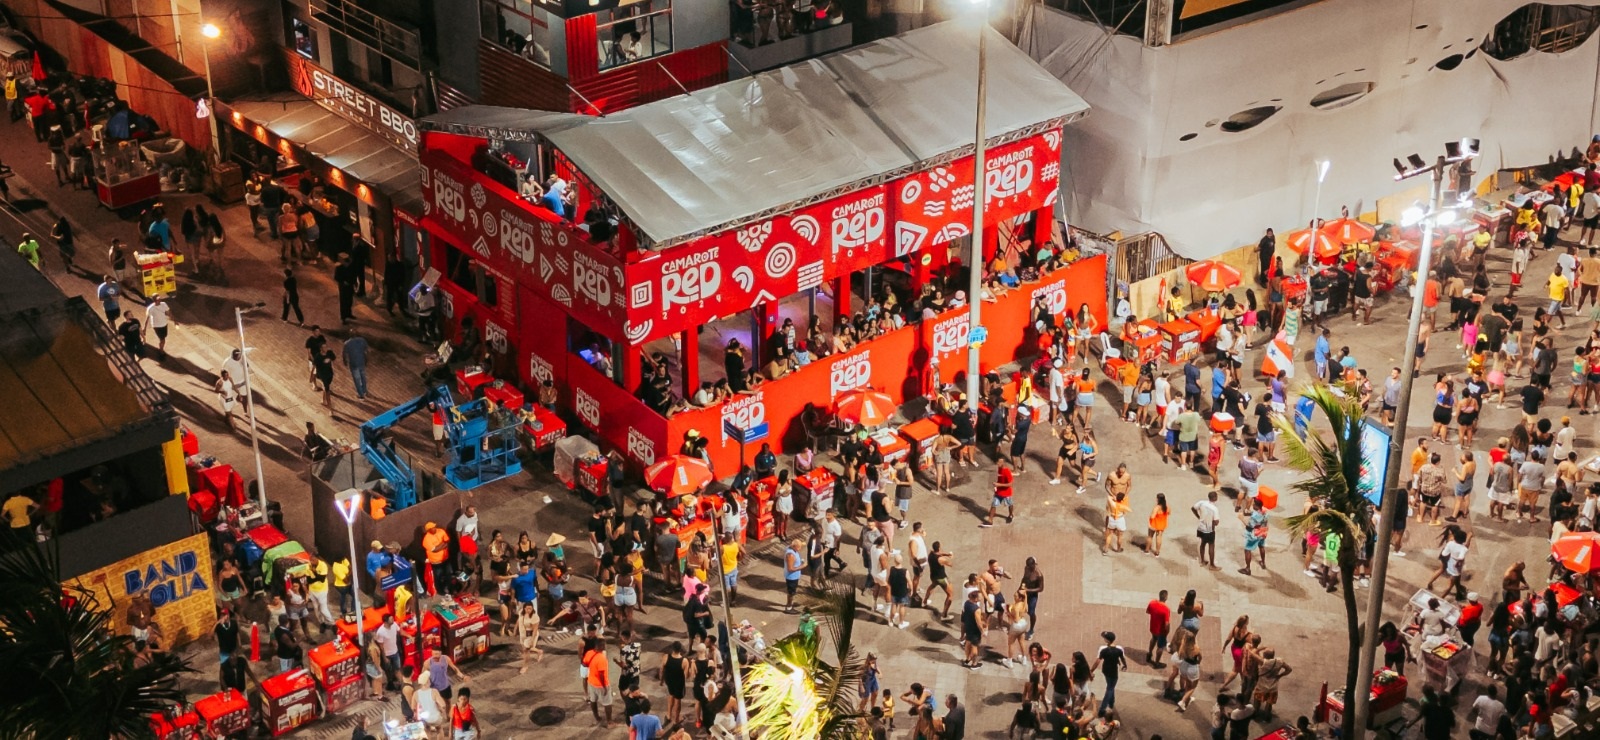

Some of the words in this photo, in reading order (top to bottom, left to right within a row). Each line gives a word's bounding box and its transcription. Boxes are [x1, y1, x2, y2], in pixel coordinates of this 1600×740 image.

[313, 70, 376, 117] STREET
[380, 105, 417, 144] BBQ
[985, 145, 1034, 171] CAMAROTE
[831, 192, 885, 219] CAMAROTE
[573, 250, 609, 277] CAMAROTE
[661, 246, 720, 275] CAMAROTE
[721, 391, 764, 415] CAMAROTE
[124, 550, 198, 596] BAND
[149, 572, 209, 608] OLIA
